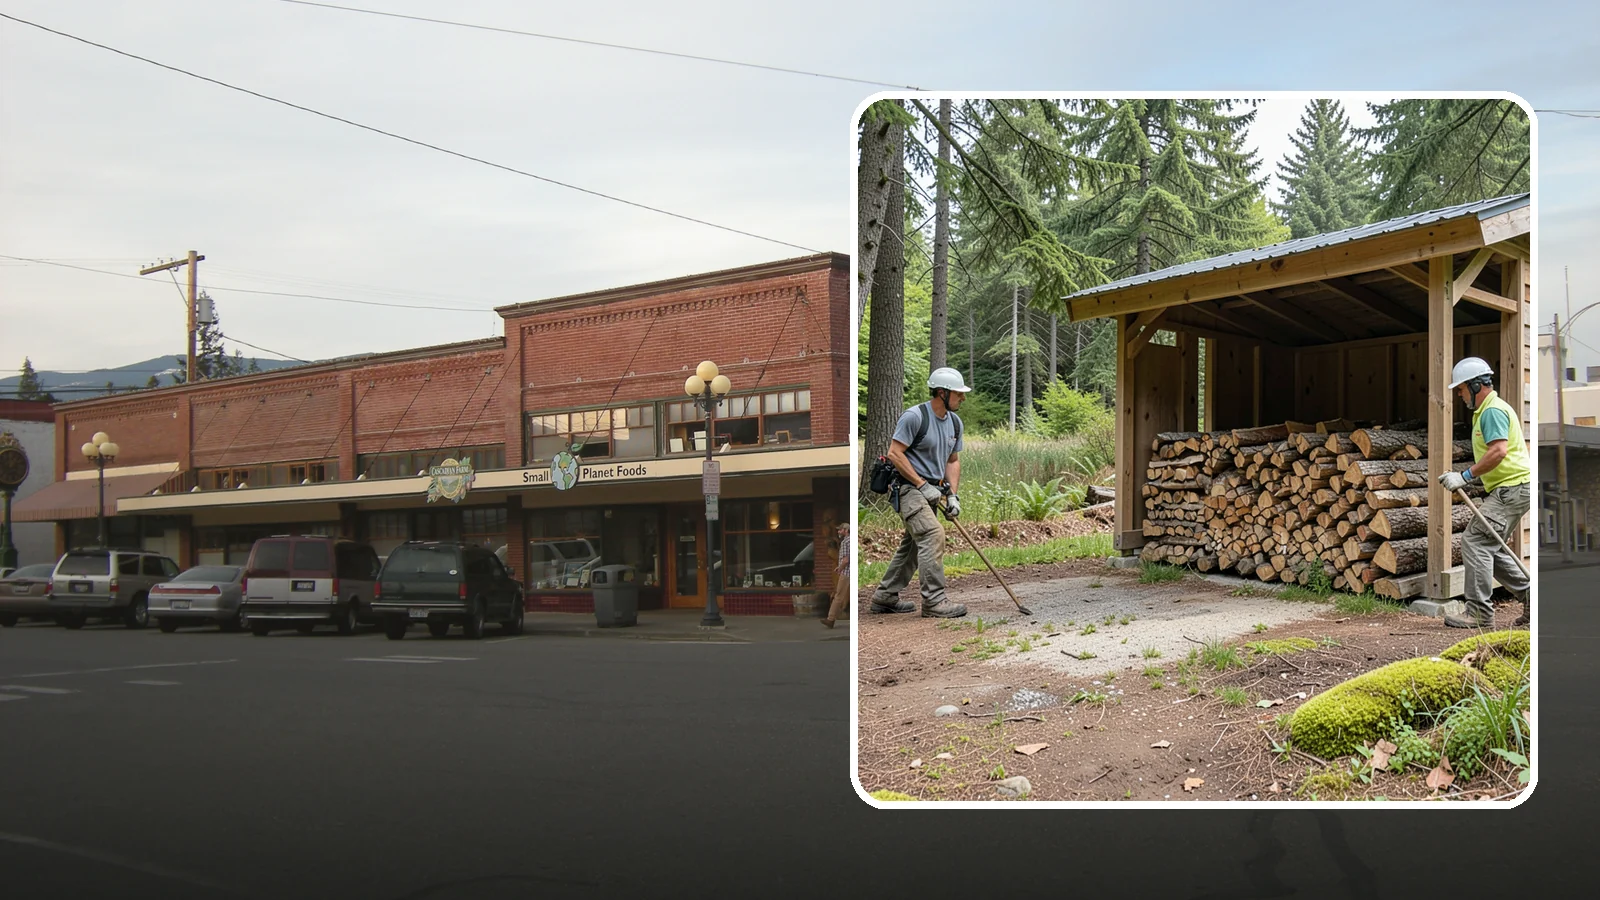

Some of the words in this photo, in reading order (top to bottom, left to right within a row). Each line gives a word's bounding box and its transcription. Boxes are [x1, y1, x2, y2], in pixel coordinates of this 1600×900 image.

[523, 471, 549, 483] Small
[582, 467, 614, 479] Planet
[616, 464, 647, 477] Foods
